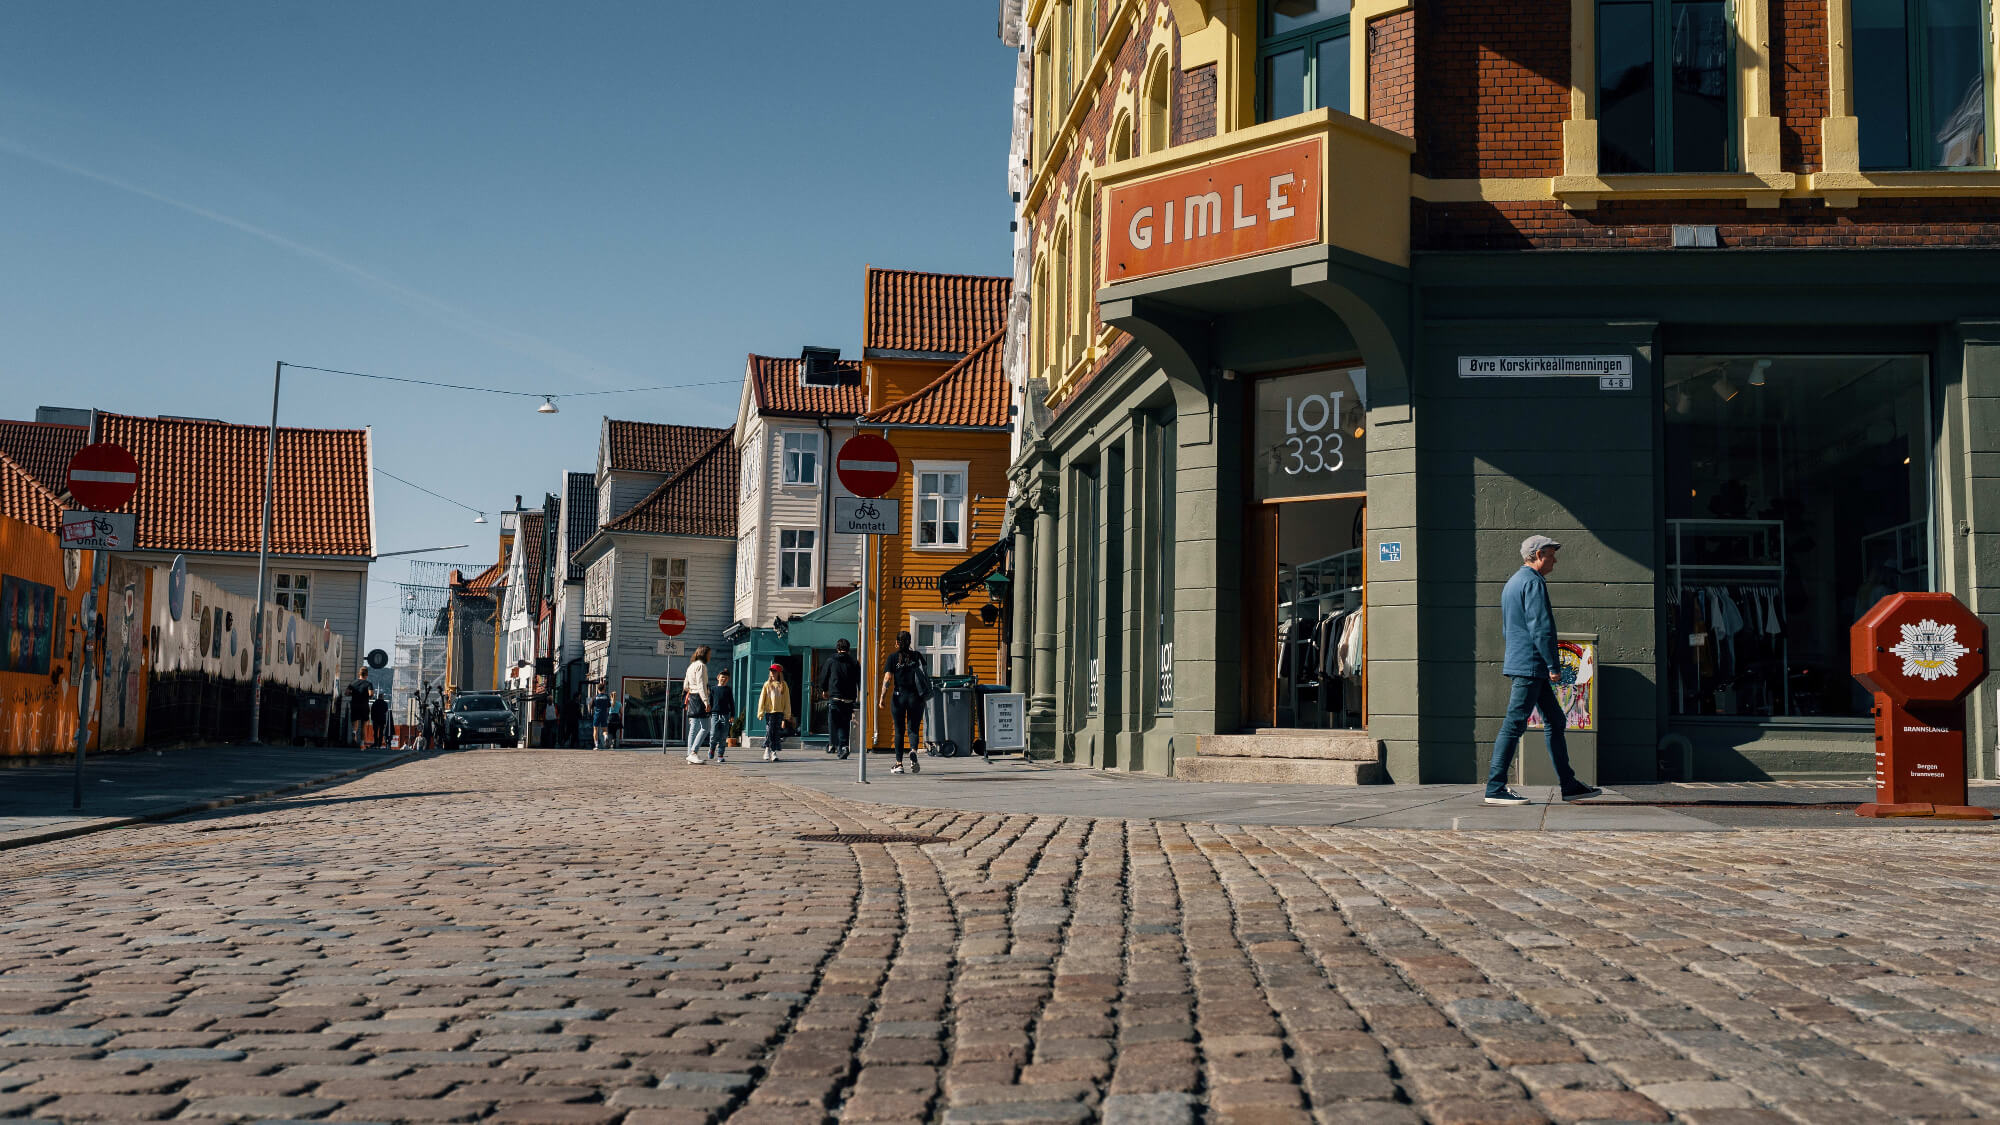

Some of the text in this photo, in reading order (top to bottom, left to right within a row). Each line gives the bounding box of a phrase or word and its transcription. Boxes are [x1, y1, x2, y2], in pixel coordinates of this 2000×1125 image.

[1129, 172, 1295, 249] GIMLE
[1470, 359, 1496, 372] Øvre
[1286, 391, 1344, 434] LOT
[1284, 433, 1343, 474] 333
[848, 520, 886, 531] Unntatt
[1161, 642, 1172, 673] LOT
[1160, 673, 1172, 702] 333
